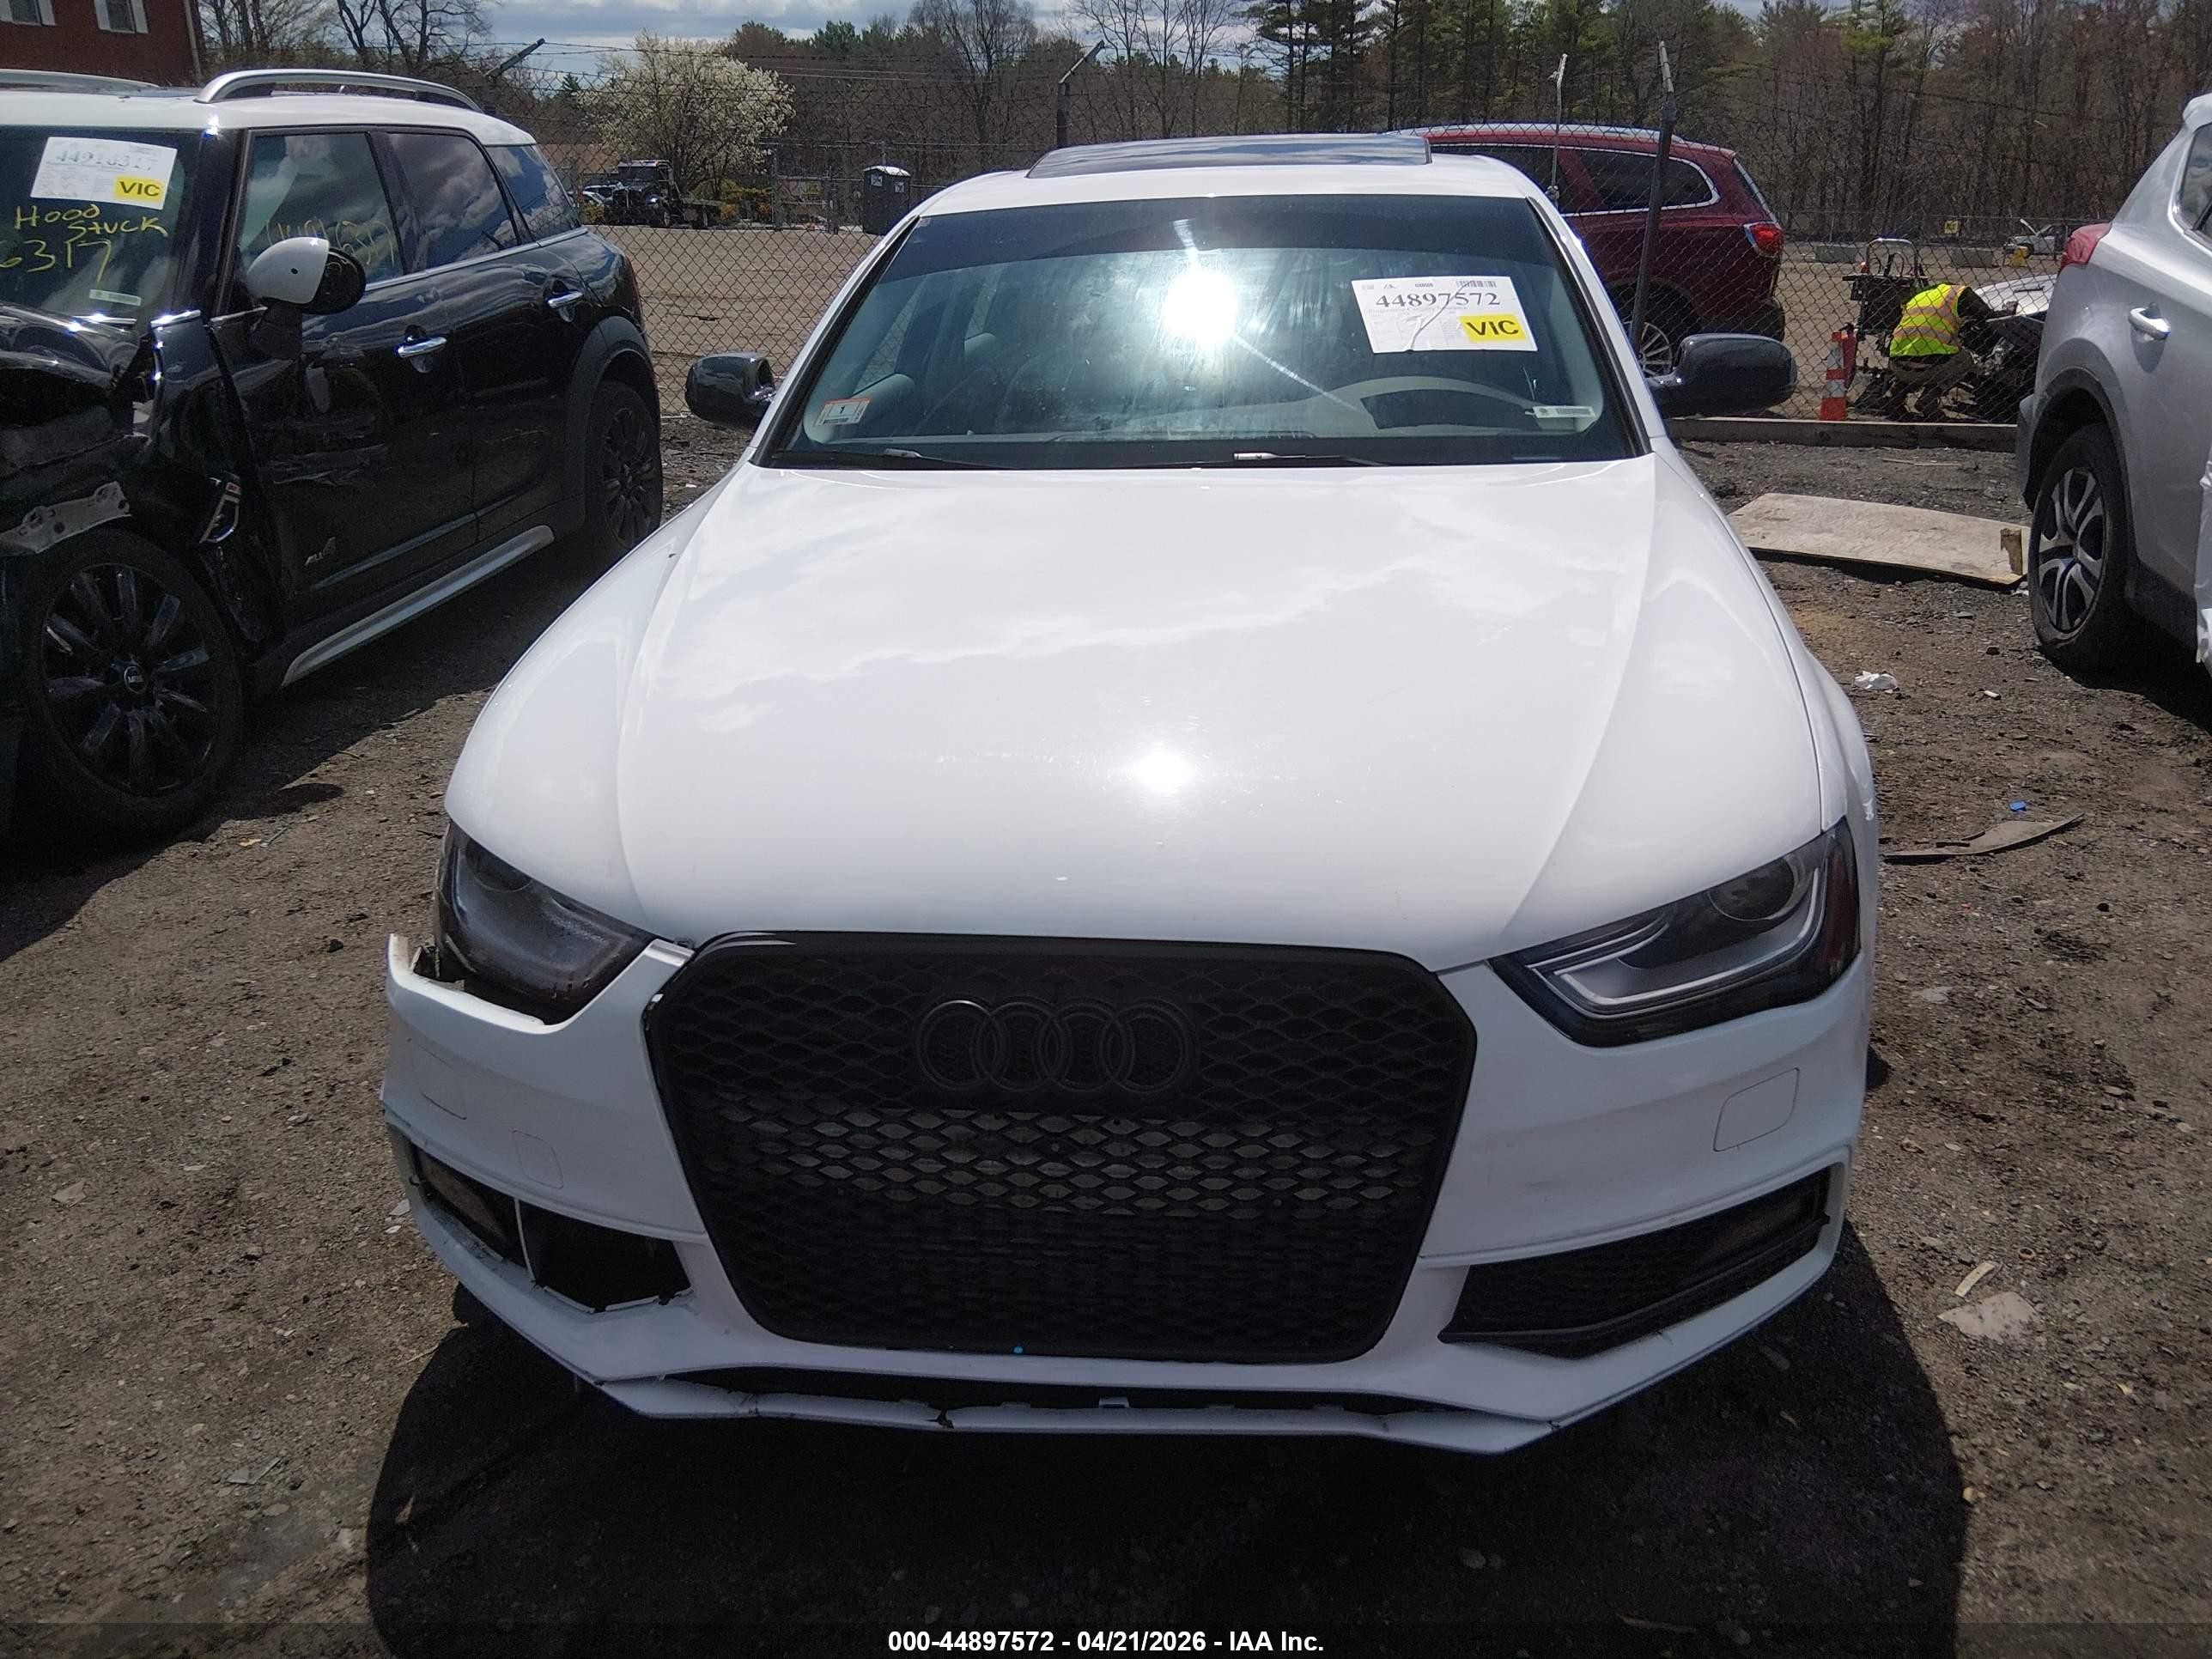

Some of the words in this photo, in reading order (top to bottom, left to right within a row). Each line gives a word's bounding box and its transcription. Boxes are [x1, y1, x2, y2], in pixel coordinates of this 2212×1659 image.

[119, 180, 161, 198] VIC
[1376, 292, 1501, 308] 44897572
[1466, 319, 1519, 336] VIC
